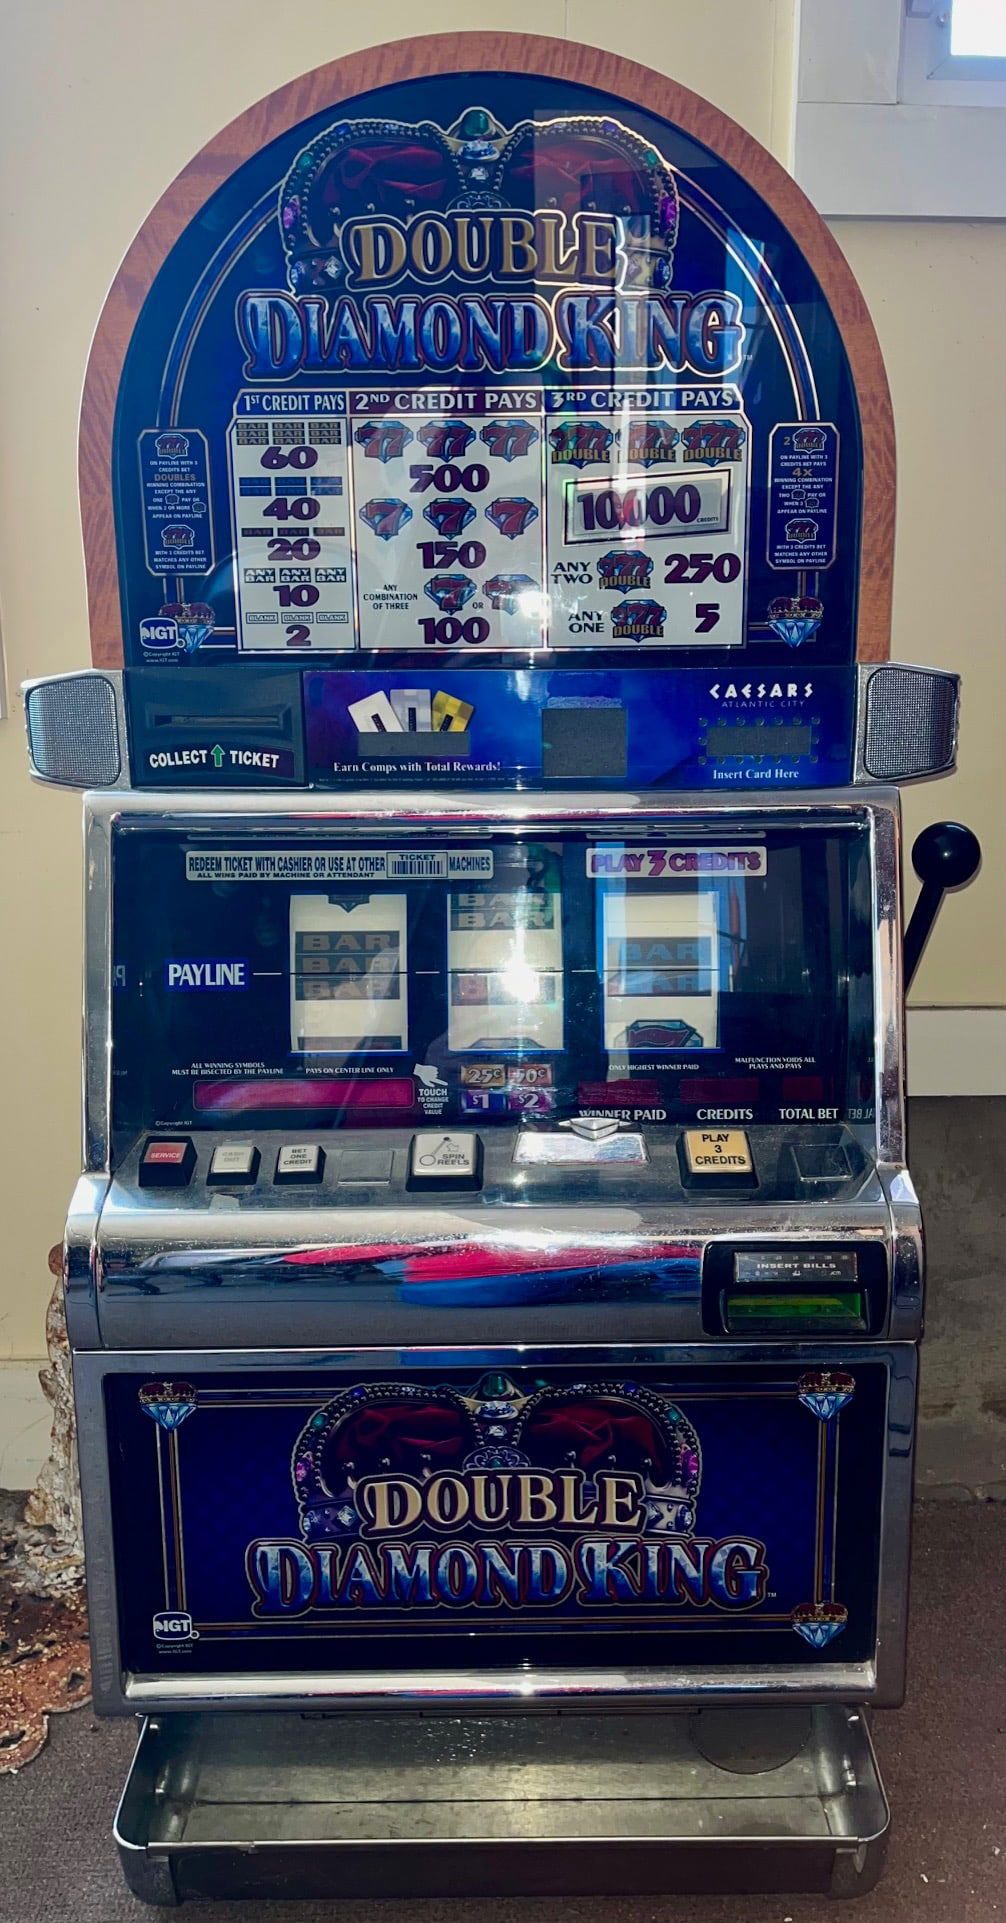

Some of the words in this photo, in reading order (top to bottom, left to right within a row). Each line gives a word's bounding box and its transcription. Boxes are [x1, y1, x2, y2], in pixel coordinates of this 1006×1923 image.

[353, 214, 620, 284] DOUBLE
[249, 294, 552, 375] DIAMOND
[558, 292, 740, 372] KING
[244, 395, 260, 411] 1ST
[262, 394, 310, 411] CREDIT
[314, 394, 345, 411] PAYS
[355, 393, 390, 410] 2ND
[394, 392, 478, 410] CREDIT
[485, 392, 537, 409] PAYS
[552, 391, 587, 408] 3RD
[591, 391, 675, 408] CREDIT
[681, 390, 735, 407] PAYS
[783, 436, 791, 446] 2
[260, 446, 319, 470] 60
[552, 449, 610, 463] DOUBLE
[684, 448, 743, 463] DOUBLE
[154, 473, 197, 481] DOUBLES
[409, 463, 490, 493] 500
[263, 497, 321, 521] 40
[577, 484, 702, 531] 10,000
[367, 502, 402, 535] 7
[431, 502, 468, 535] 7
[494, 501, 530, 534] 7
[267, 538, 321, 561] 20
[416, 541, 487, 569] 150
[245, 568, 275, 576] ANY
[553, 561, 591, 573] ANY
[664, 553, 742, 584] 250
[382, 584, 398, 592] ANY
[550, 574, 593, 585] TWO
[598, 575, 651, 590] DOUBLE
[273, 584, 320, 607] 10
[363, 592, 419, 601] COMBINATION
[372, 602, 384, 610] OF
[385, 602, 409, 610] THREE
[472, 602, 484, 610] OR
[569, 610, 602, 622] ANY
[694, 603, 721, 634] 5
[150, 626, 176, 640] IGT
[286, 624, 312, 647] 2
[418, 616, 491, 645] 100
[568, 622, 605, 633] ONE
[612, 623, 665, 639] DOUBLE
[709, 683, 813, 700] CAESARS
[149, 750, 208, 769] COLLECT
[229, 750, 280, 769] TICKET
[333, 762, 359, 772] Earn
[361, 762, 397, 775] Comps
[399, 762, 422, 772] with
[424, 762, 450, 772] Total
[453, 761, 501, 772] Rewards!
[713, 769, 743, 779] Insert
[745, 769, 772, 779] Card
[775, 768, 800, 779] Here
[189, 857, 222, 872] REDEEM
[224, 857, 253, 872] TICKET
[255, 857, 276, 872] WITH
[277, 857, 313, 872] CASHIER
[314, 857, 326, 872] OR
[328, 856, 344, 872] USE
[346, 856, 357, 871] AT
[358, 856, 386, 871] OTHER
[449, 856, 491, 871] MACHINES
[591, 853, 645, 873] PLAY
[647, 850, 668, 876] 3
[668, 852, 762, 873] CREDITS
[302, 934, 390, 951] BAR
[168, 963, 245, 986] PAYLINE
[419, 1088, 448, 1096] TOUCH
[472, 1094, 490, 1109] $1
[519, 1093, 539, 1108] $2
[579, 1109, 631, 1120] WINNER
[633, 1109, 667, 1121] PAID
[696, 1108, 754, 1120] CREDITS
[778, 1108, 817, 1120] TOTAL
[817, 1108, 839, 1120] BET
[702, 1134, 730, 1143] PLAY
[715, 1145, 722, 1154] 3
[695, 1155, 746, 1165] CREDITS
[362, 1472, 646, 1532] DOUBLE
[255, 1540, 574, 1613] DIAMOND
[579, 1539, 765, 1608] KING
[163, 1619, 191, 1632] IGT
